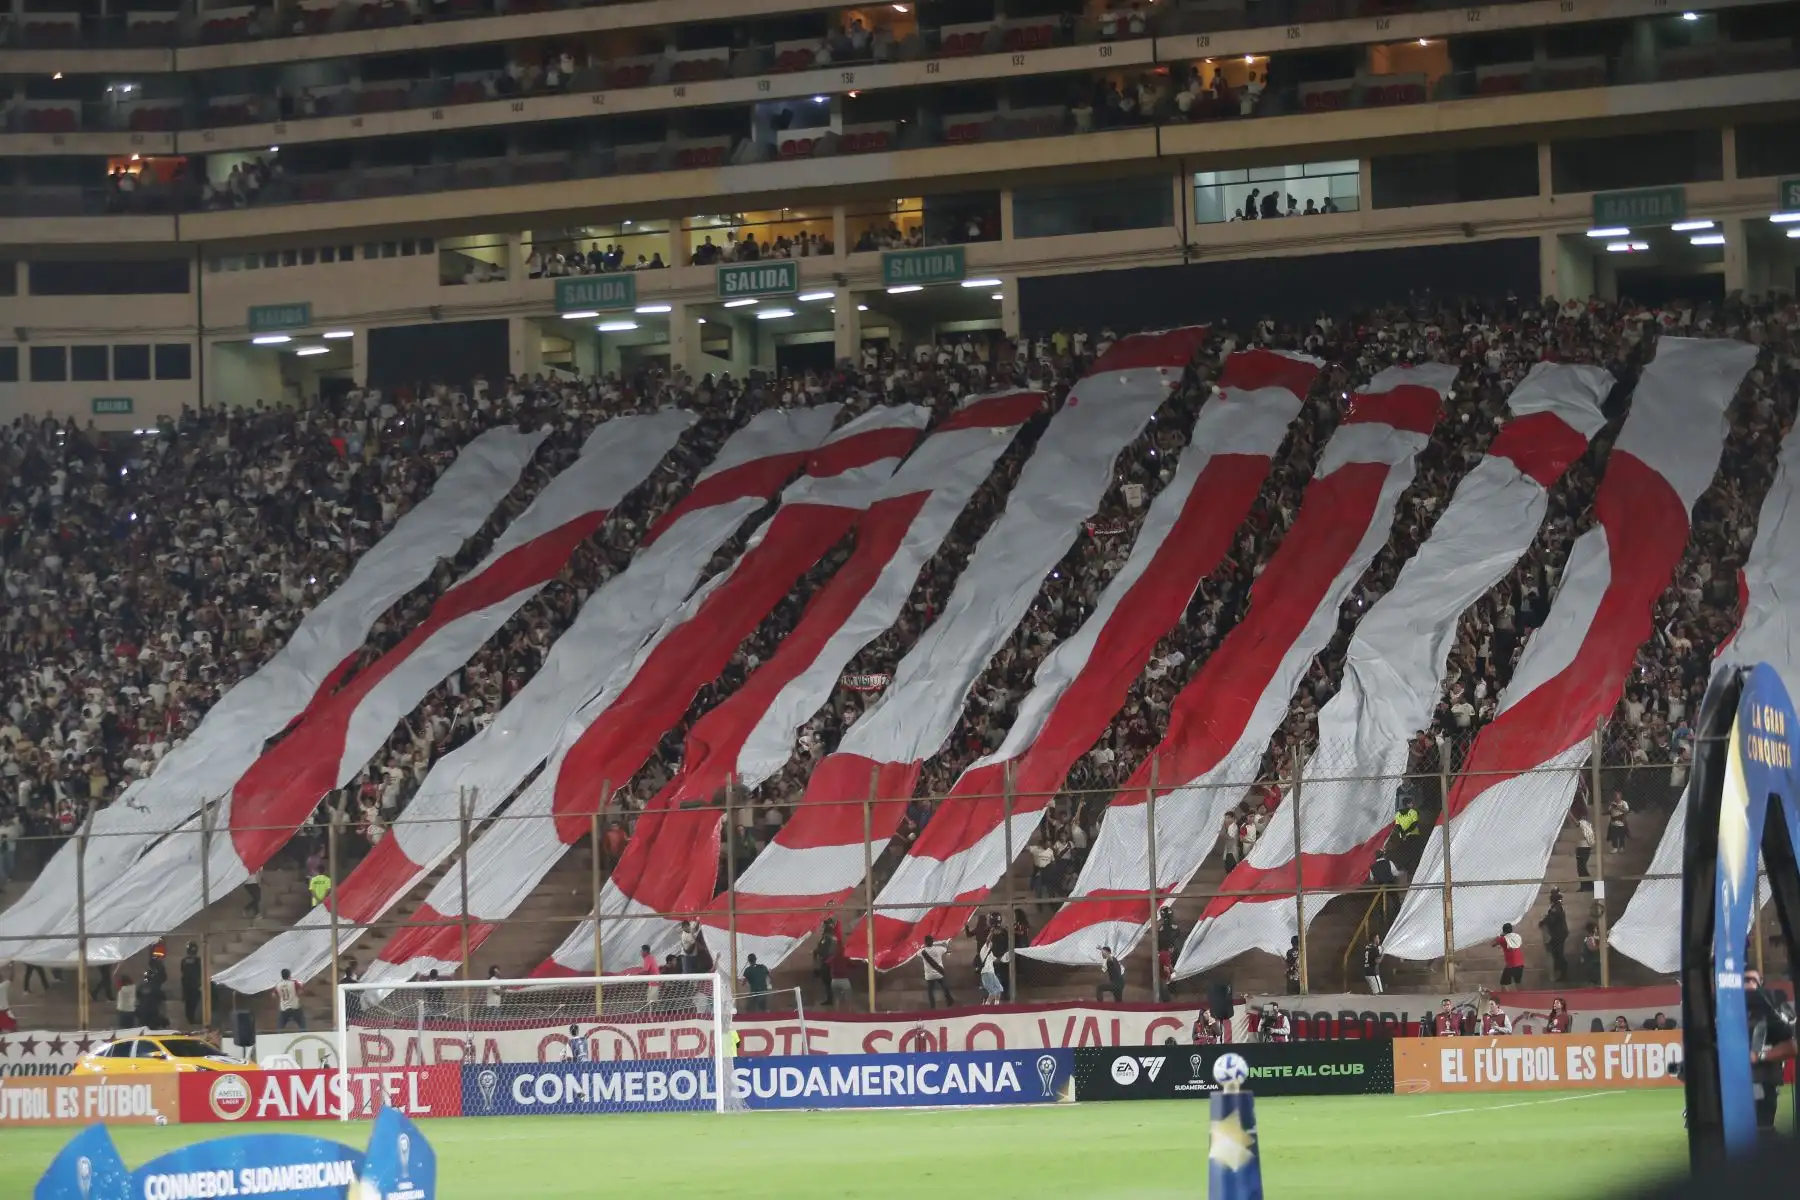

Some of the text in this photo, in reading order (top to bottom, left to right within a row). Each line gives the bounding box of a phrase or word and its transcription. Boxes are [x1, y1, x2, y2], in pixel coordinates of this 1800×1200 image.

[1012, 55, 1025, 67] 132
[1098, 45, 1112, 58] 130
[926, 62, 940, 75] 134
[889, 254, 956, 279] SALIDA
[564, 280, 626, 304] SALIDA
[724, 267, 790, 293] SALIDA
[1752, 703, 1785, 736] LA GRAN
[1747, 733, 1791, 770] CONQUISTA
[1117, 1062, 1133, 1072] EA
[1248, 1063, 1365, 1078] NETE AL CLUB
[1441, 1034, 1682, 1083] EL FÚTBOL ES FÚTBO
[256, 1072, 431, 1117] AMSTEL
[512, 1061, 1022, 1106] CONMEBOL SUDAMERICANA
[56, 1086, 78, 1119] ES
[85, 1076, 159, 1118] FÚTBOL
[145, 1159, 356, 1200] CONMEBOL SUDAMERICANA
